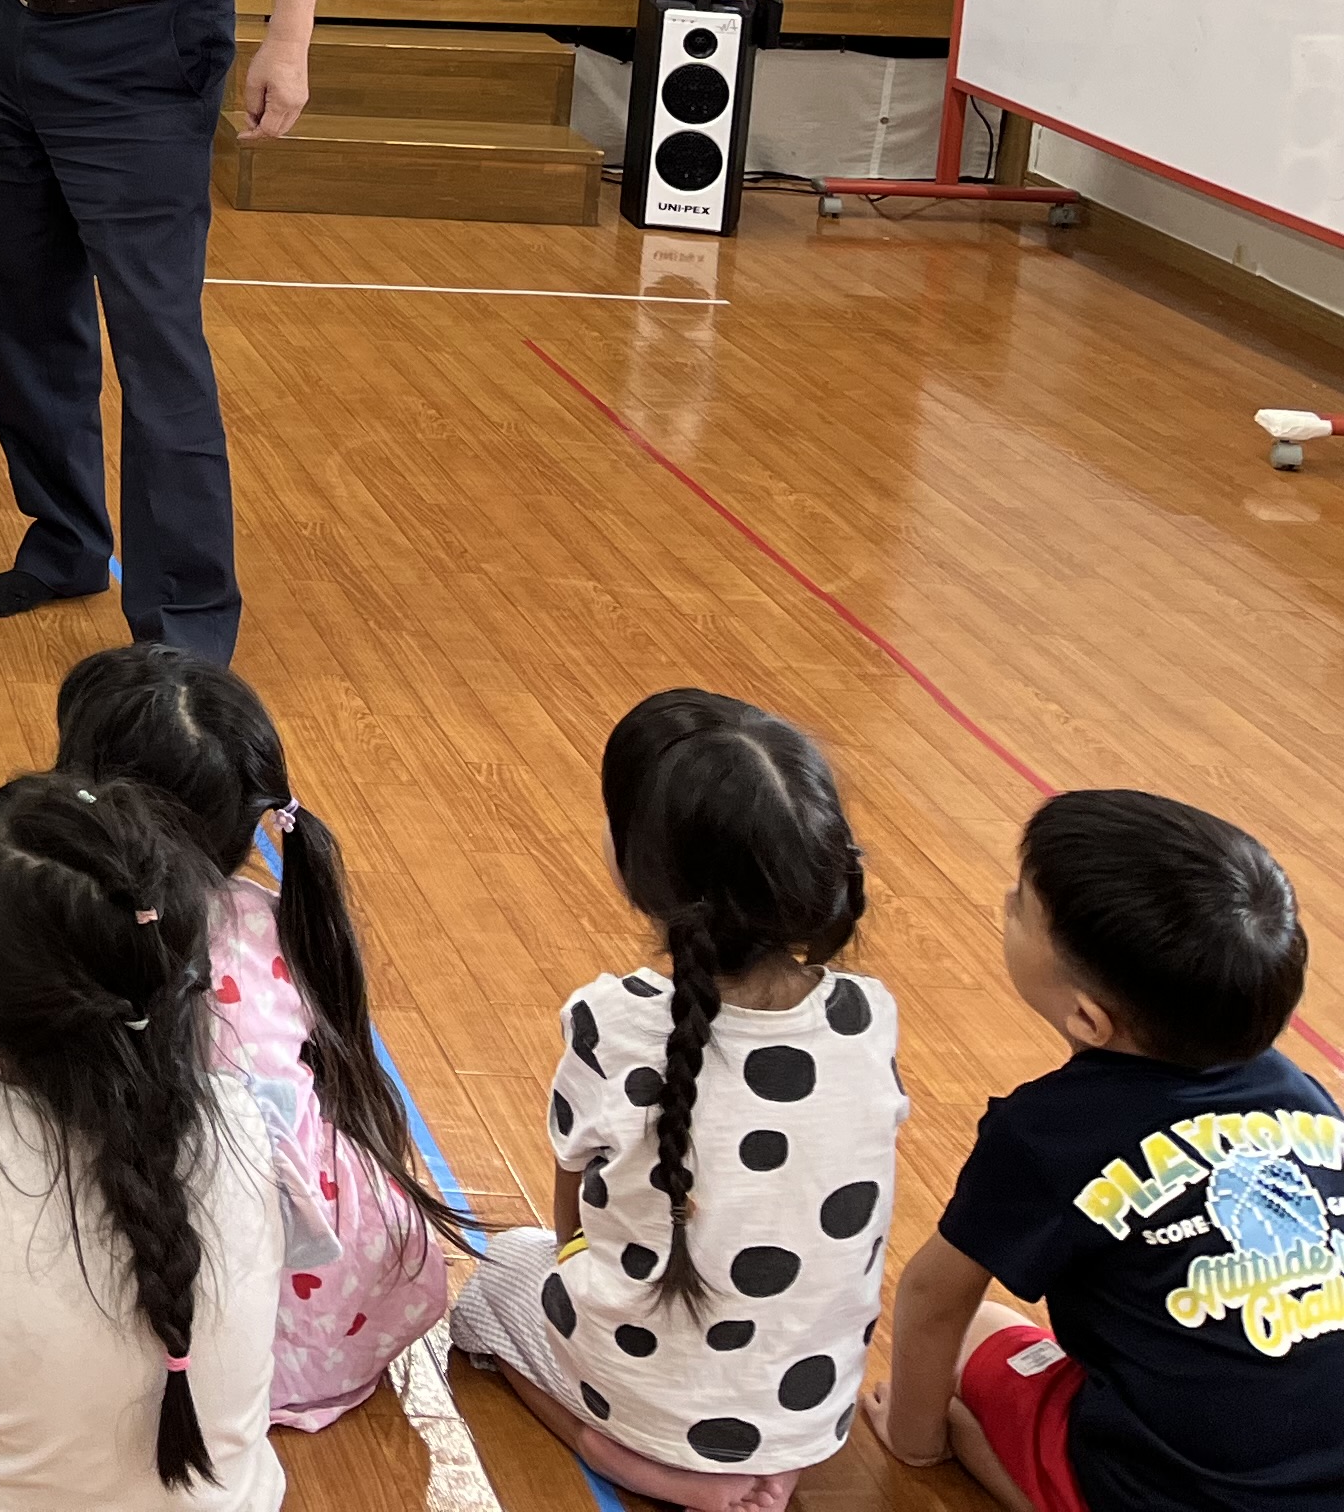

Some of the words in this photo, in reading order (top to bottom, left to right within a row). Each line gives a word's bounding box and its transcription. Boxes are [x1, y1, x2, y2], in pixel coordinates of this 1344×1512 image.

[658, 202, 710, 215] UNI-PEX
[1142, 1216, 1209, 1245] SCORE
[1241, 1273, 1344, 1358] Chall
